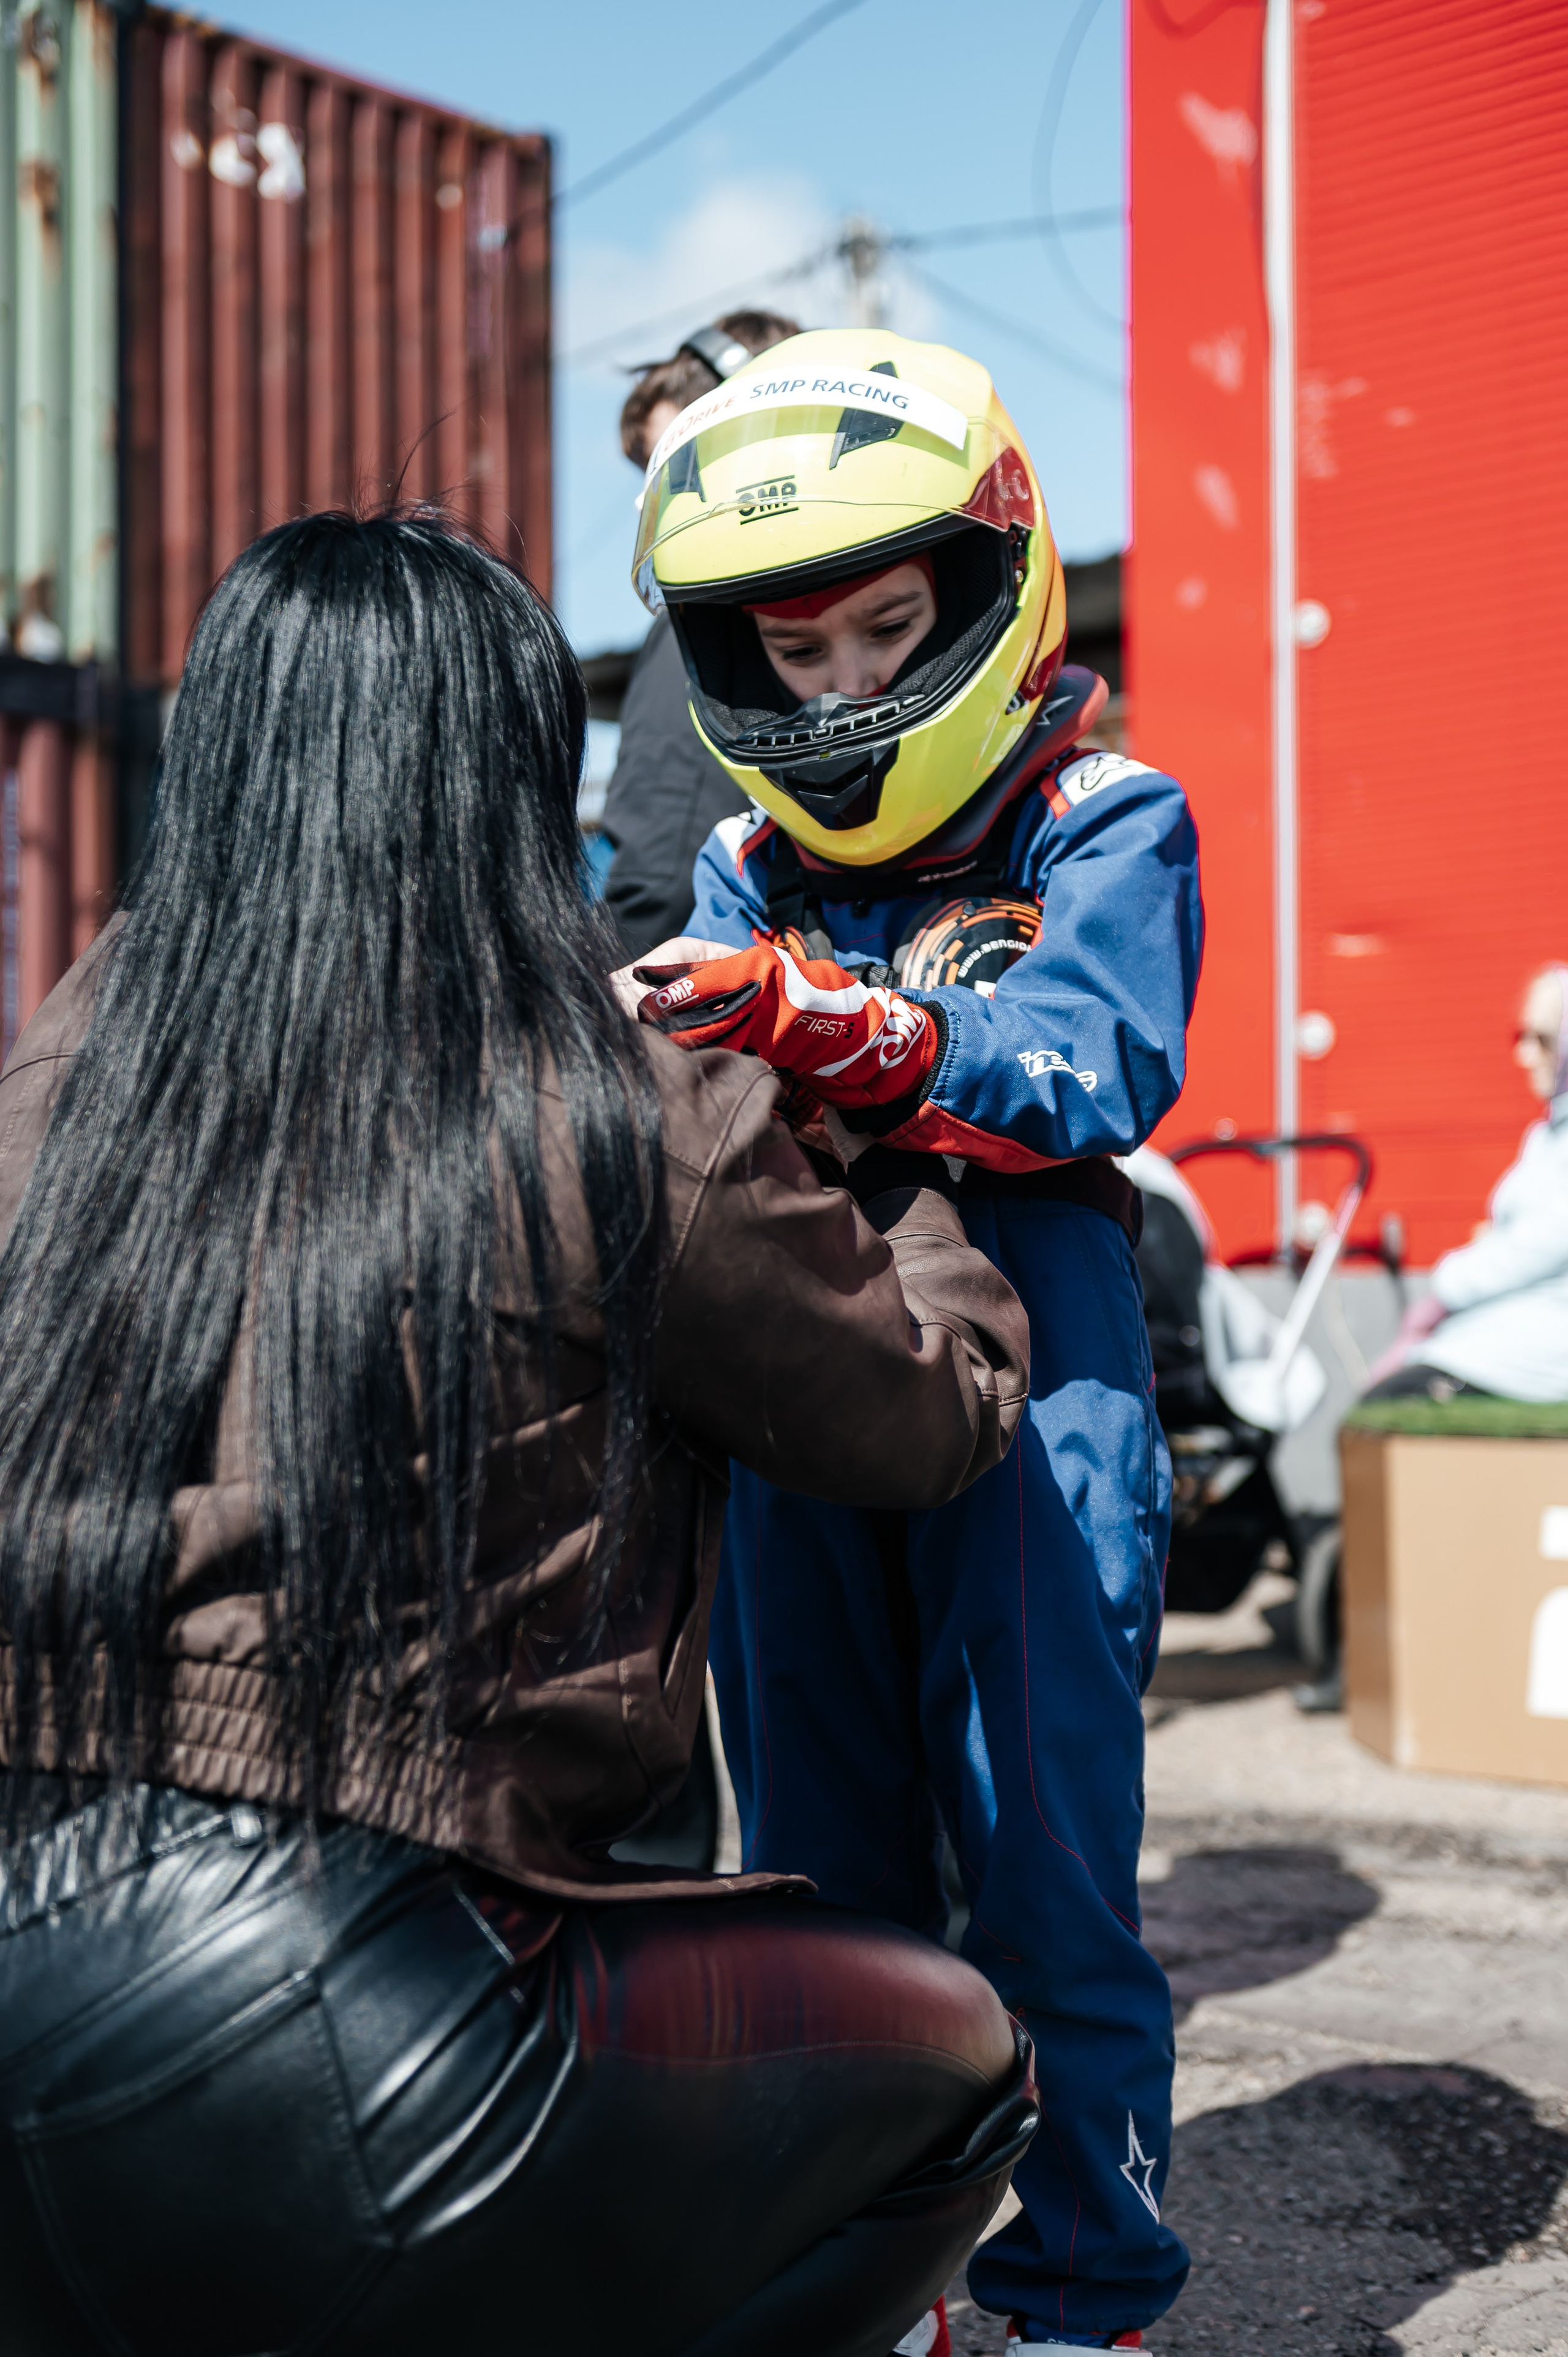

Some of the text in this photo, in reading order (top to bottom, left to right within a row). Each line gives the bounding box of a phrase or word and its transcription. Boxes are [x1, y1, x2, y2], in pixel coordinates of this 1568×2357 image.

[750, 379, 806, 399] SMP
[812, 379, 909, 409] RACING
[738, 481, 797, 516] OMP
[655, 979, 695, 1009] OMP
